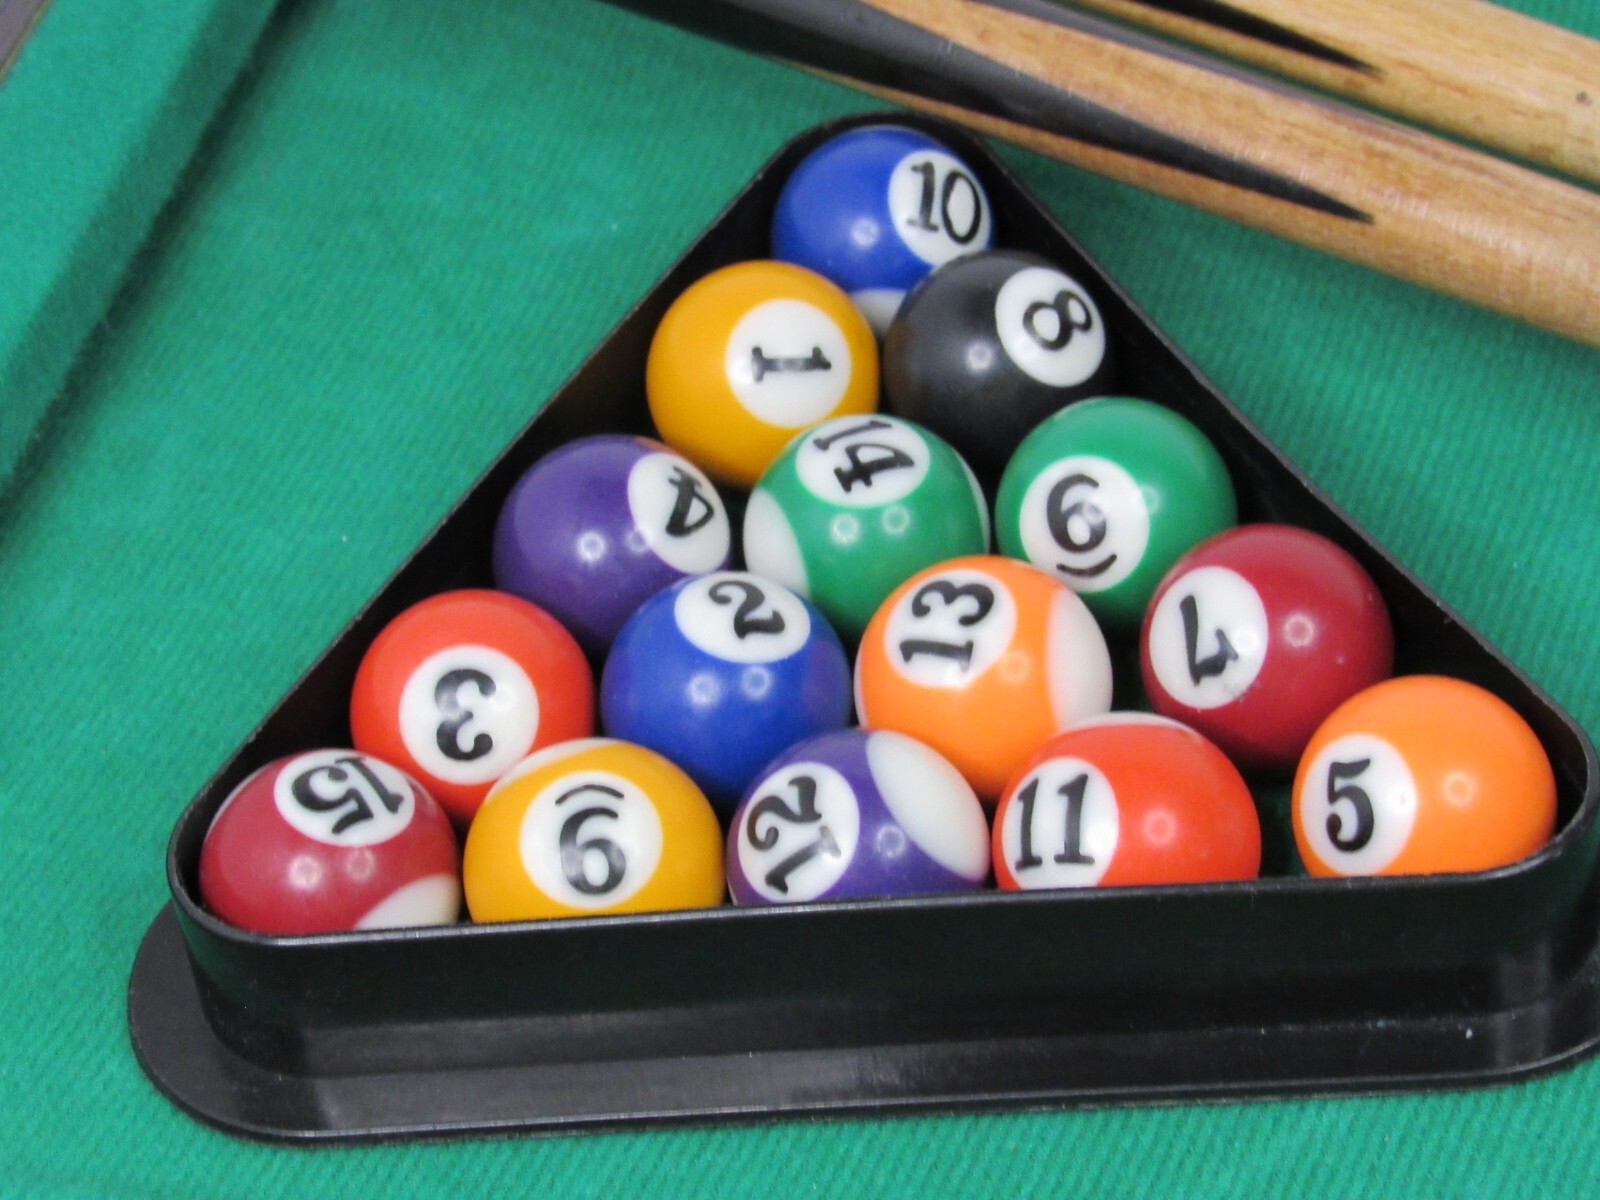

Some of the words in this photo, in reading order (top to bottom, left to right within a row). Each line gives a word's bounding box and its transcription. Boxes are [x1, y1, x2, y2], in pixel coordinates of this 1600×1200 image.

[906, 160, 982, 245] 10
[750, 344, 832, 383] 1
[1022, 289, 1092, 351] 8
[812, 419, 915, 494] 14
[667, 465, 716, 538] 4
[1045, 472, 1118, 578] 6
[708, 579, 786, 640] 2
[899, 578, 996, 674] 13
[1179, 594, 1240, 687] 7
[434, 668, 497, 762] 3
[291, 756, 406, 836] 15
[745, 774, 842, 895] 12
[1014, 772, 1096, 872] 11
[1325, 757, 1377, 852] 5
